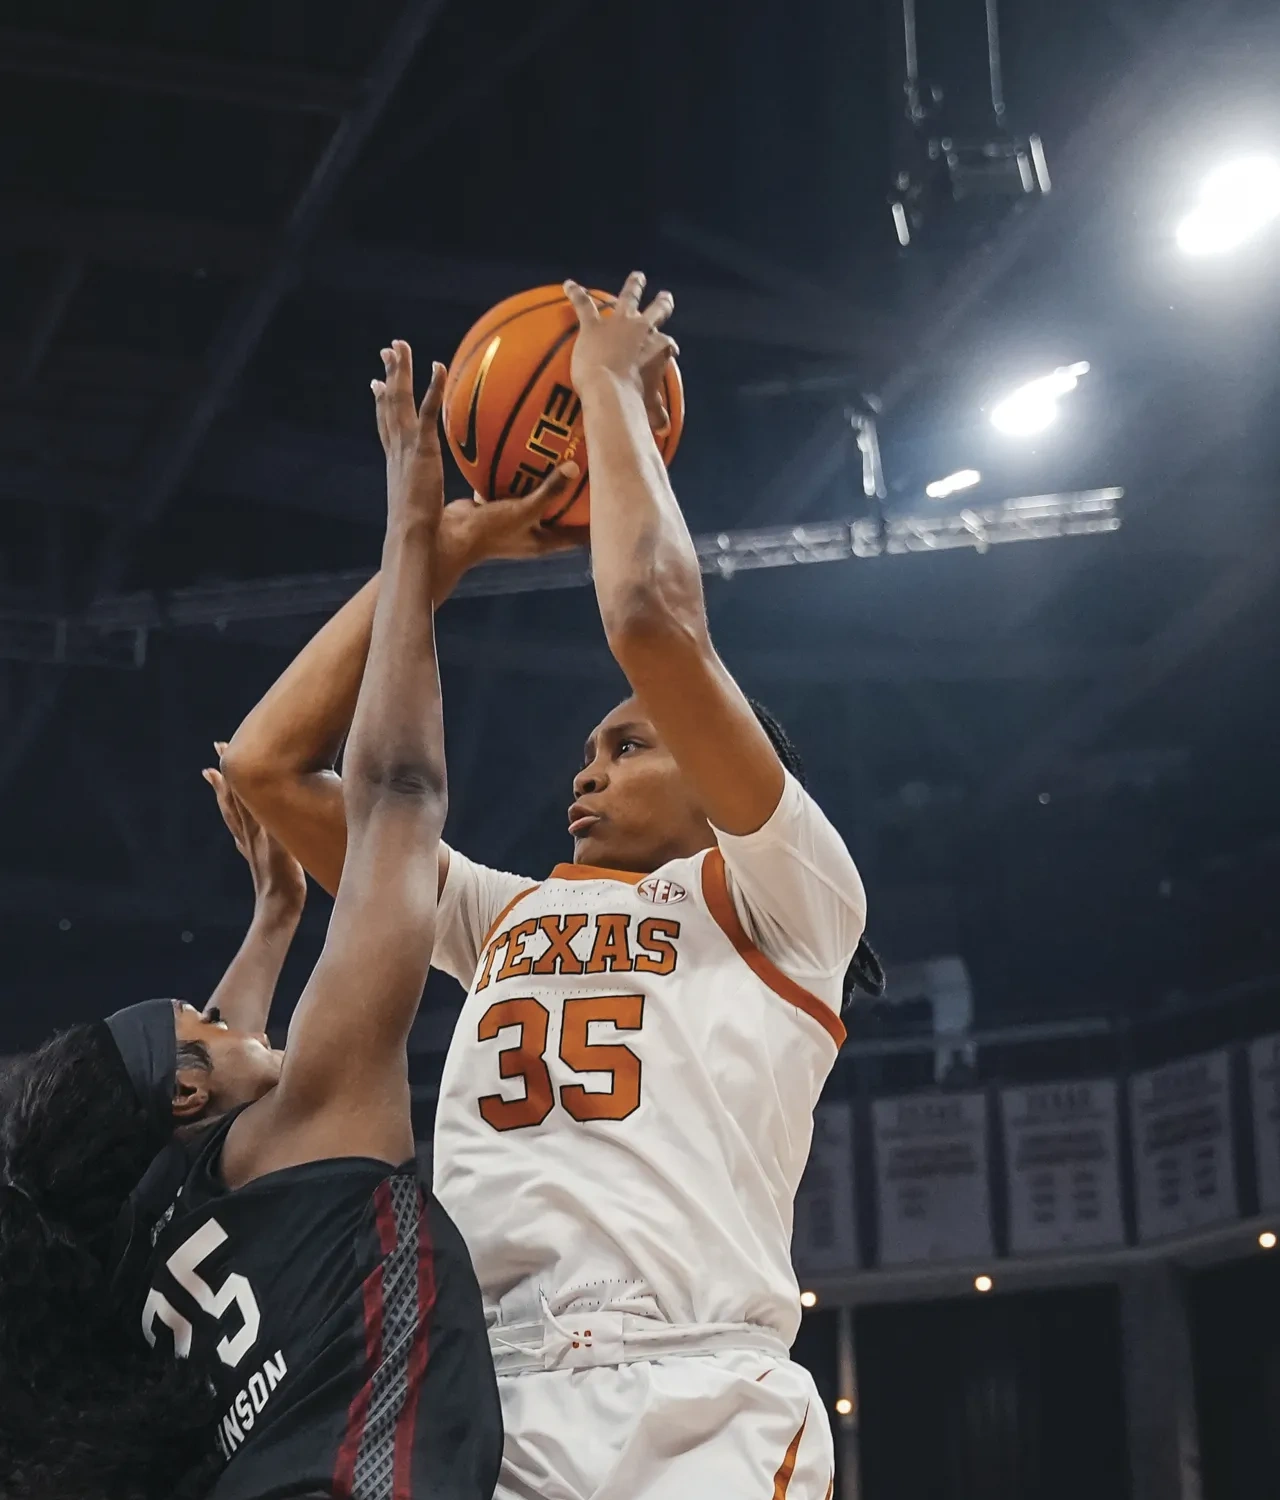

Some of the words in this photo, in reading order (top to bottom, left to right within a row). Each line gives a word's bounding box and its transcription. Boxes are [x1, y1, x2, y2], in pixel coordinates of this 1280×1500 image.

[475, 913, 680, 994] TEXAS
[477, 994, 645, 1131] 35
[216, 1350, 288, 1461] NSON
